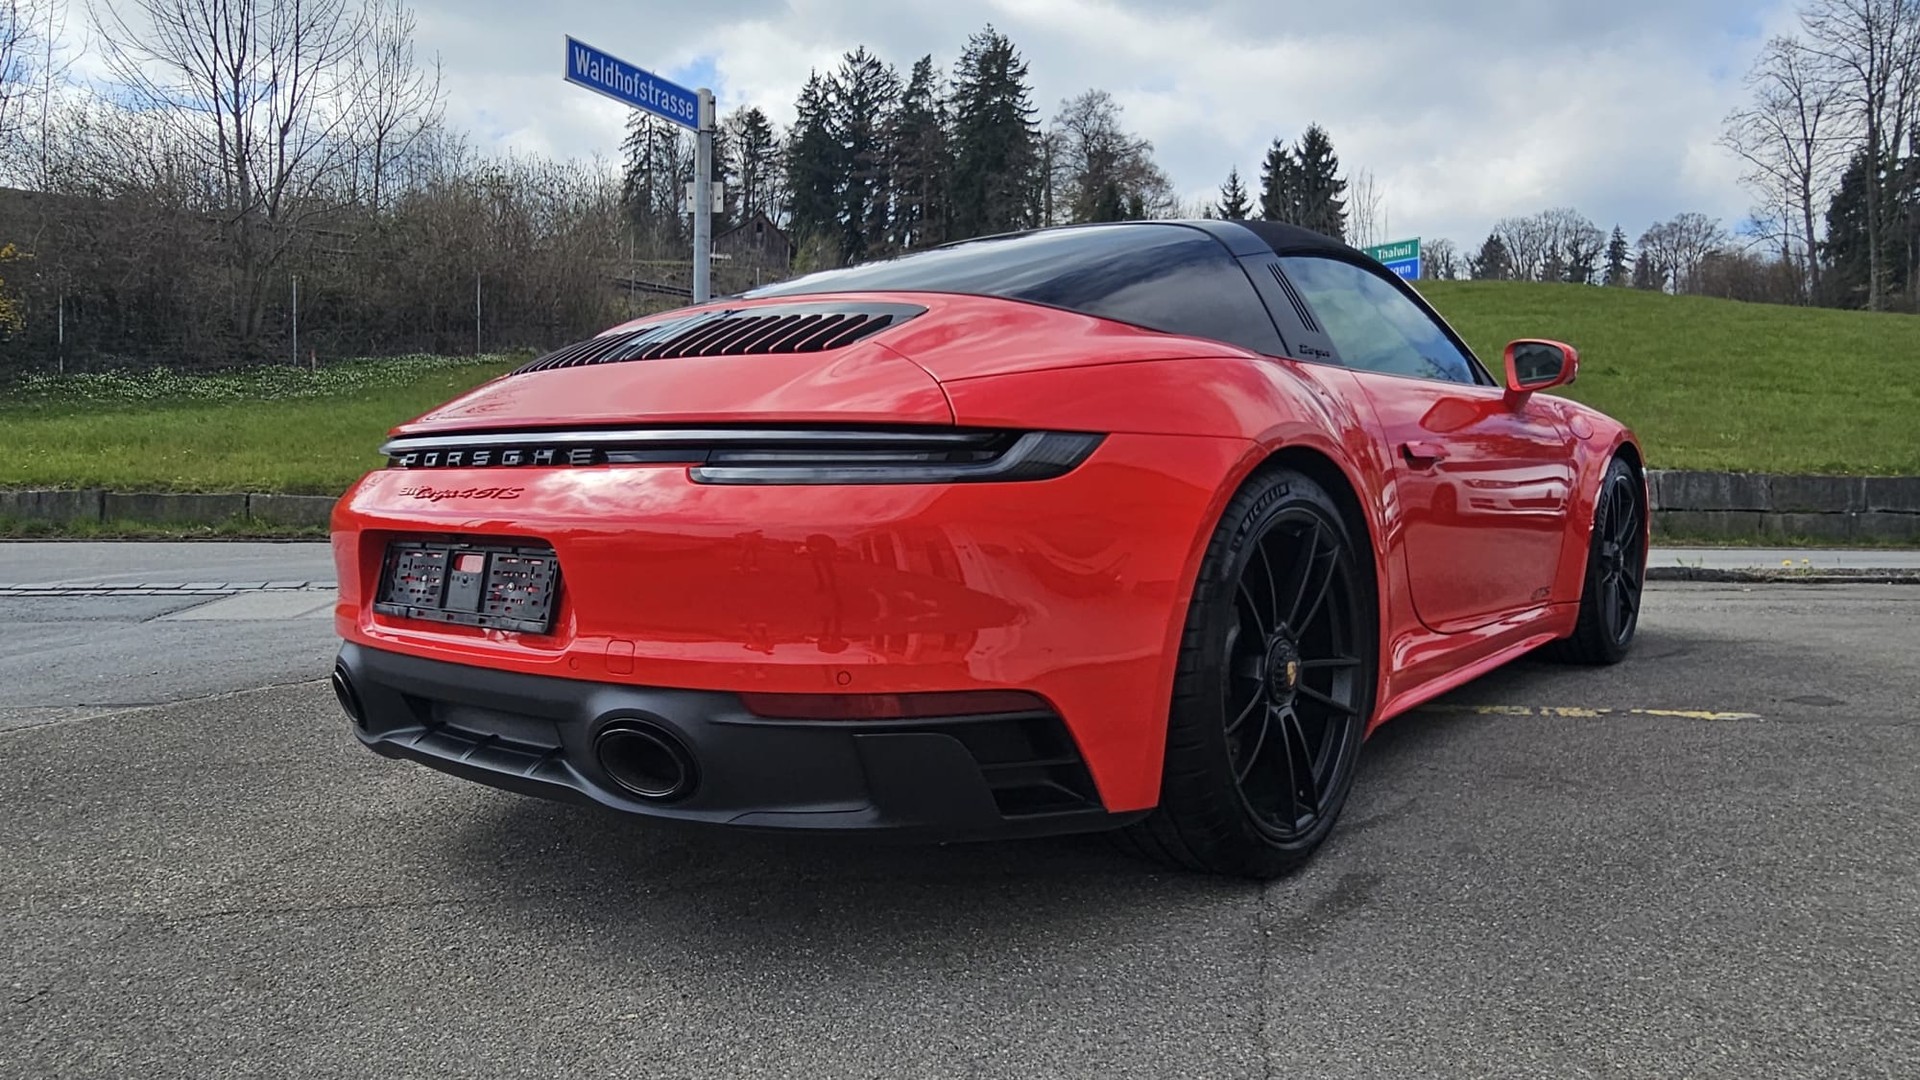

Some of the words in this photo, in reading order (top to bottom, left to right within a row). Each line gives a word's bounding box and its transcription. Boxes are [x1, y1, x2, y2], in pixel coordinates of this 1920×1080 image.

[574, 46, 694, 120] Waldhofstrasse
[1377, 244, 1412, 260] Thalwil
[400, 449, 593, 467] PORSCHE
[1241, 483, 1290, 533] MICHELIN
